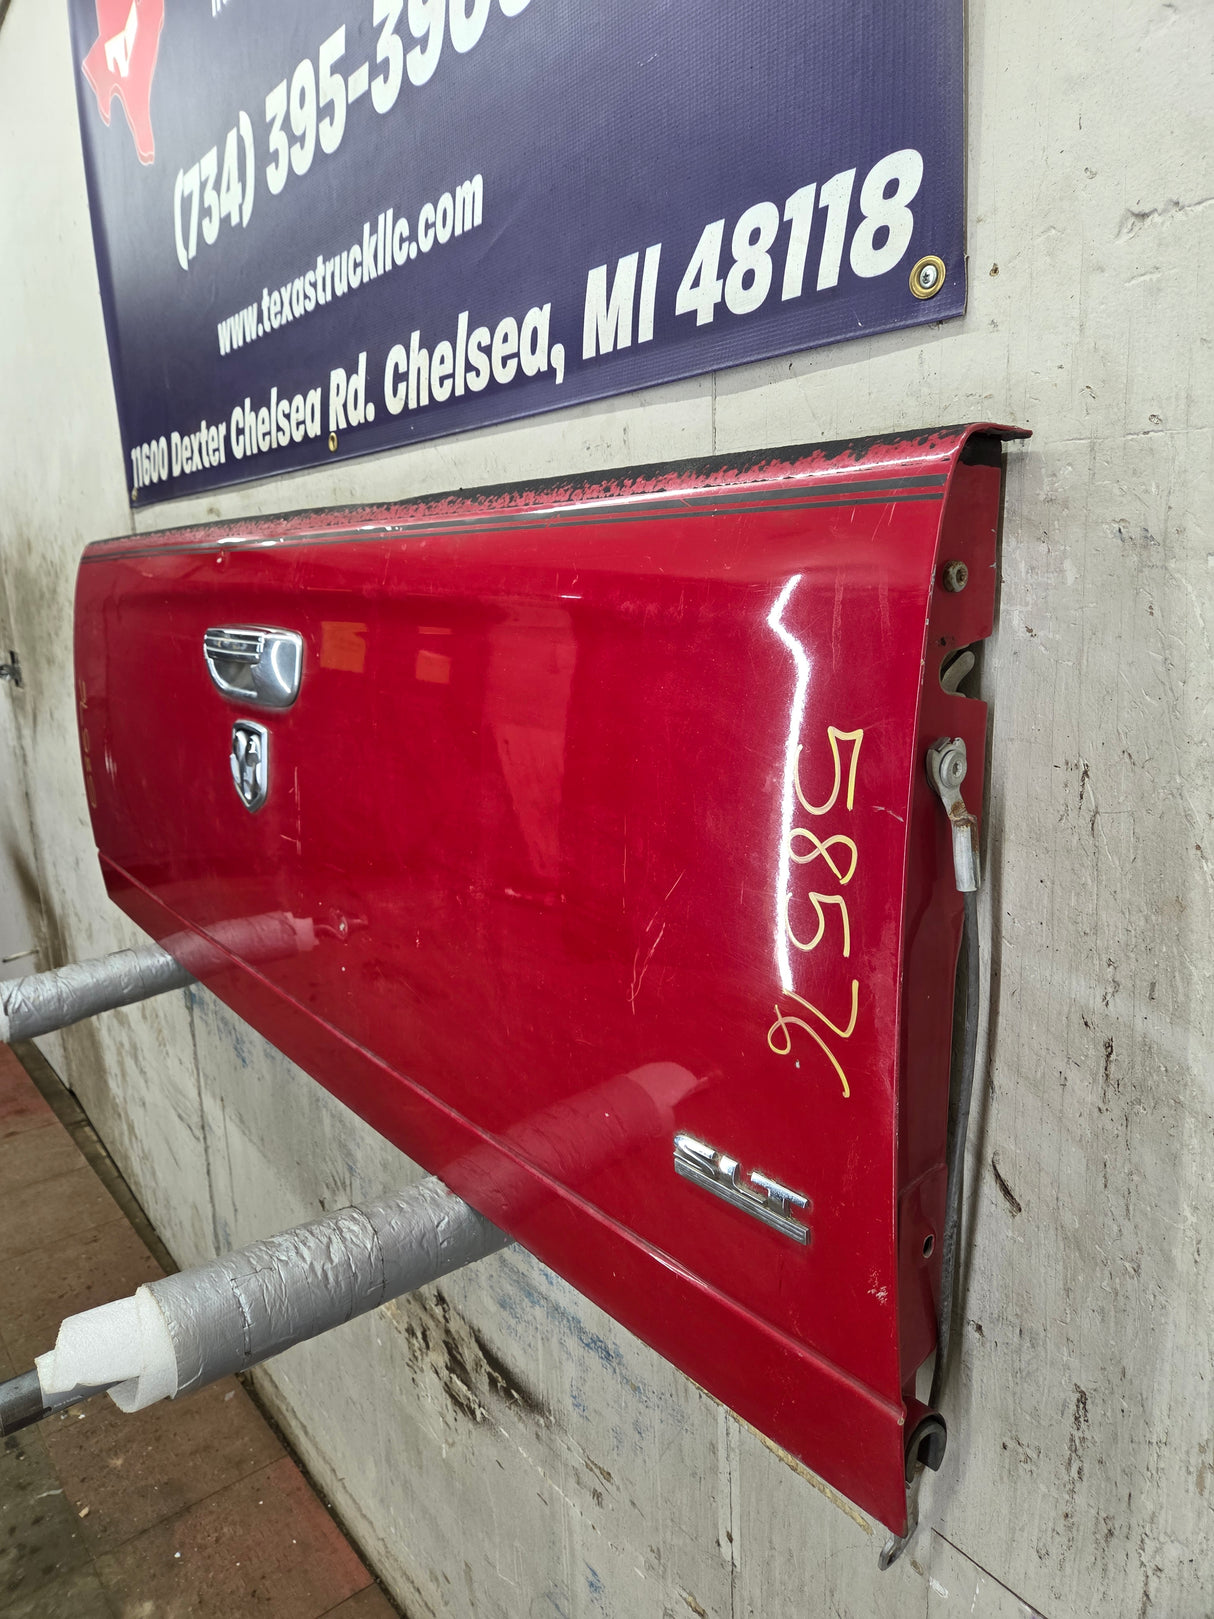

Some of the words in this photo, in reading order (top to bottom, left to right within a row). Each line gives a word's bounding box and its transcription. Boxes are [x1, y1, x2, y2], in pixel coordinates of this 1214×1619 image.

[174, 111, 255, 270] (734)
[265, 0, 532, 194] 395-39
[217, 173, 483, 355] www.texastruckllc.com
[131, 436, 168, 488] 11600
[171, 420, 226, 477] Dexter
[230, 387, 321, 459] Chelsea
[328, 351, 375, 432] Rd.
[384, 303, 565, 415] Chelsea,
[582, 243, 662, 359] MI
[675, 149, 924, 326] 48118
[767, 726, 863, 1098] 58576
[673, 1135, 809, 1218] SLT
